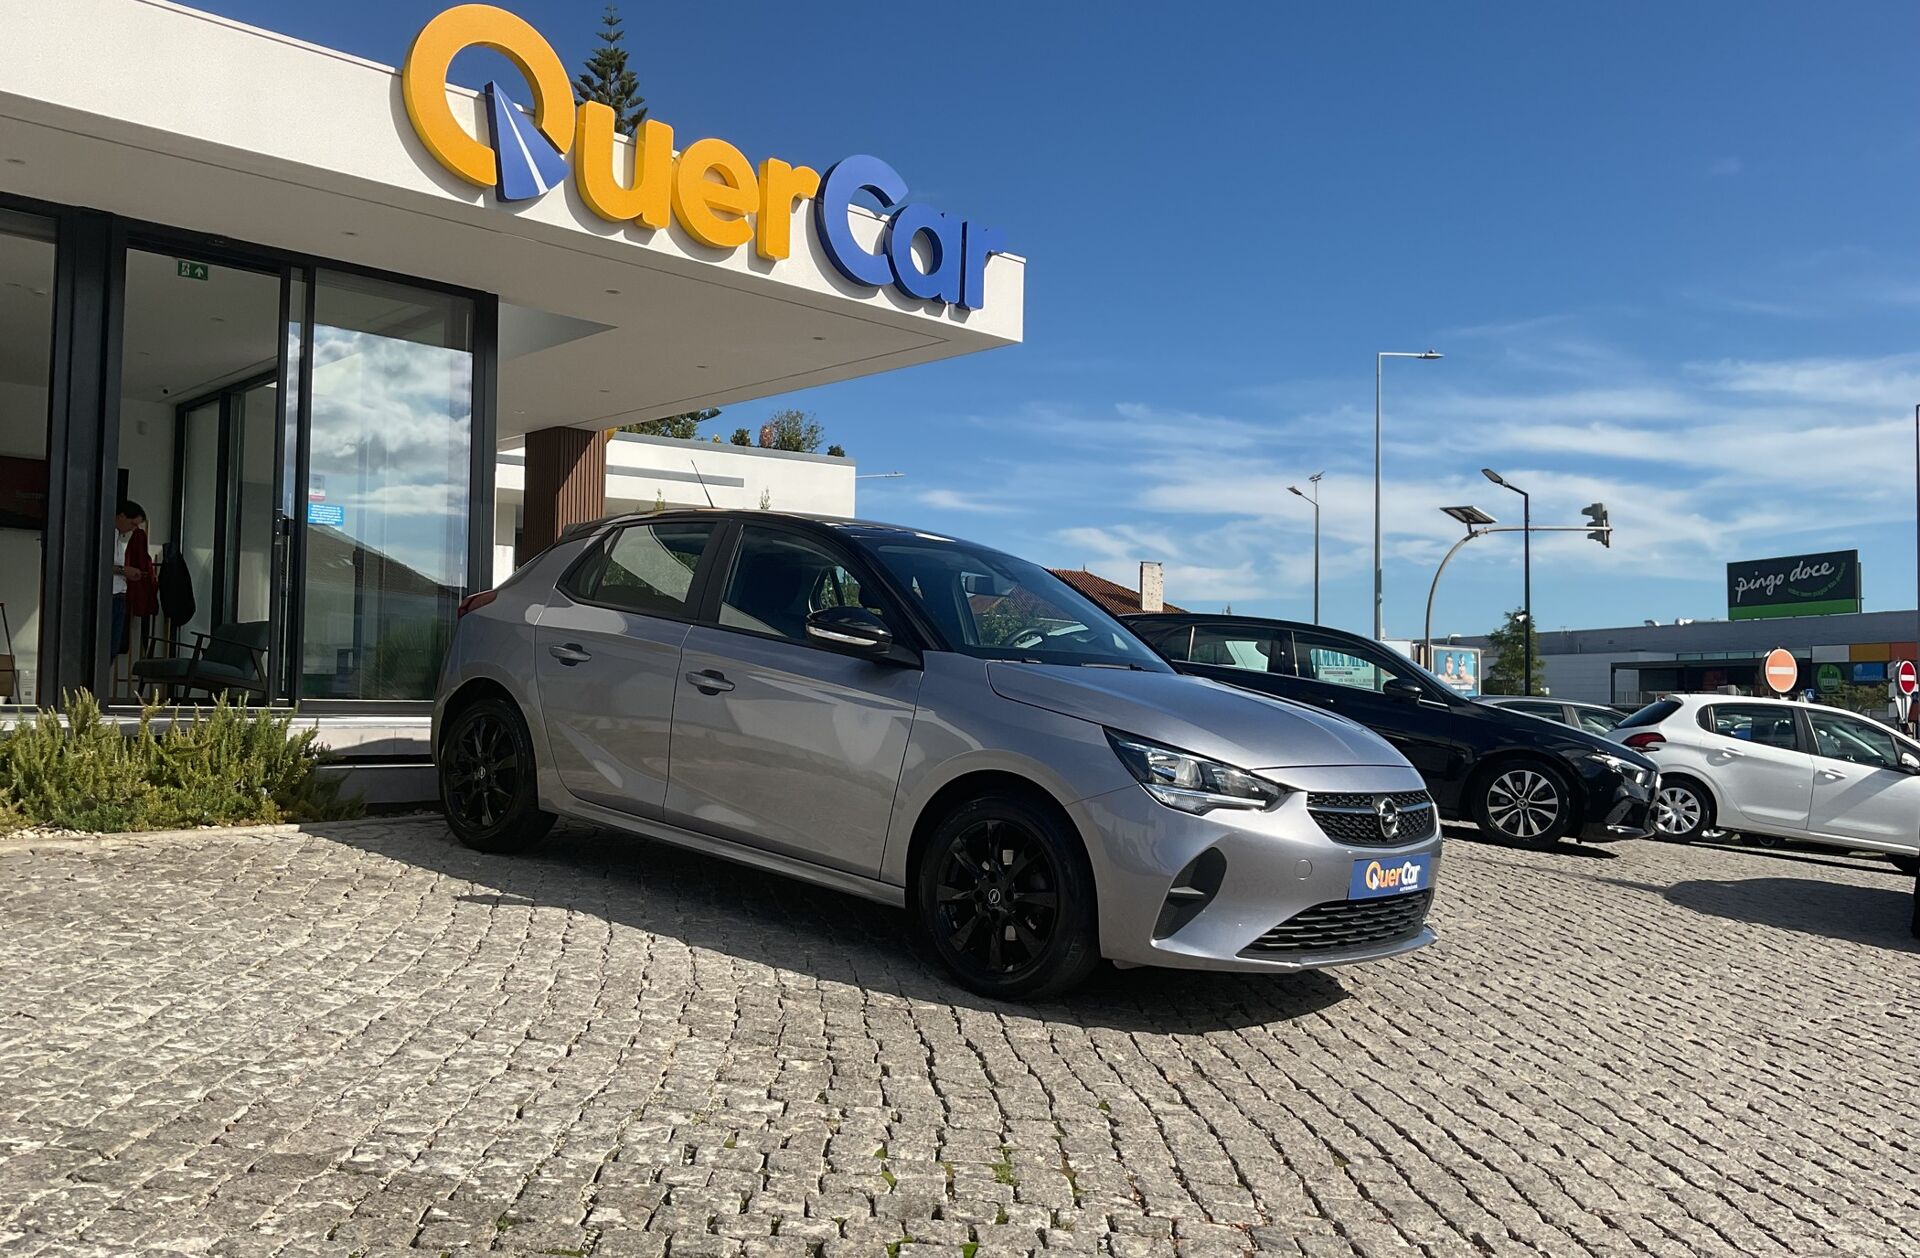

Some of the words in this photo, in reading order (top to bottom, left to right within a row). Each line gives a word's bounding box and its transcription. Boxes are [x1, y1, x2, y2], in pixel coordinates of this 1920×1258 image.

[403, 4, 1003, 310] QuerCar
[1736, 572, 1784, 603] pingo
[1789, 560, 1835, 582] doce
[1366, 861, 1421, 890] QuerCar
